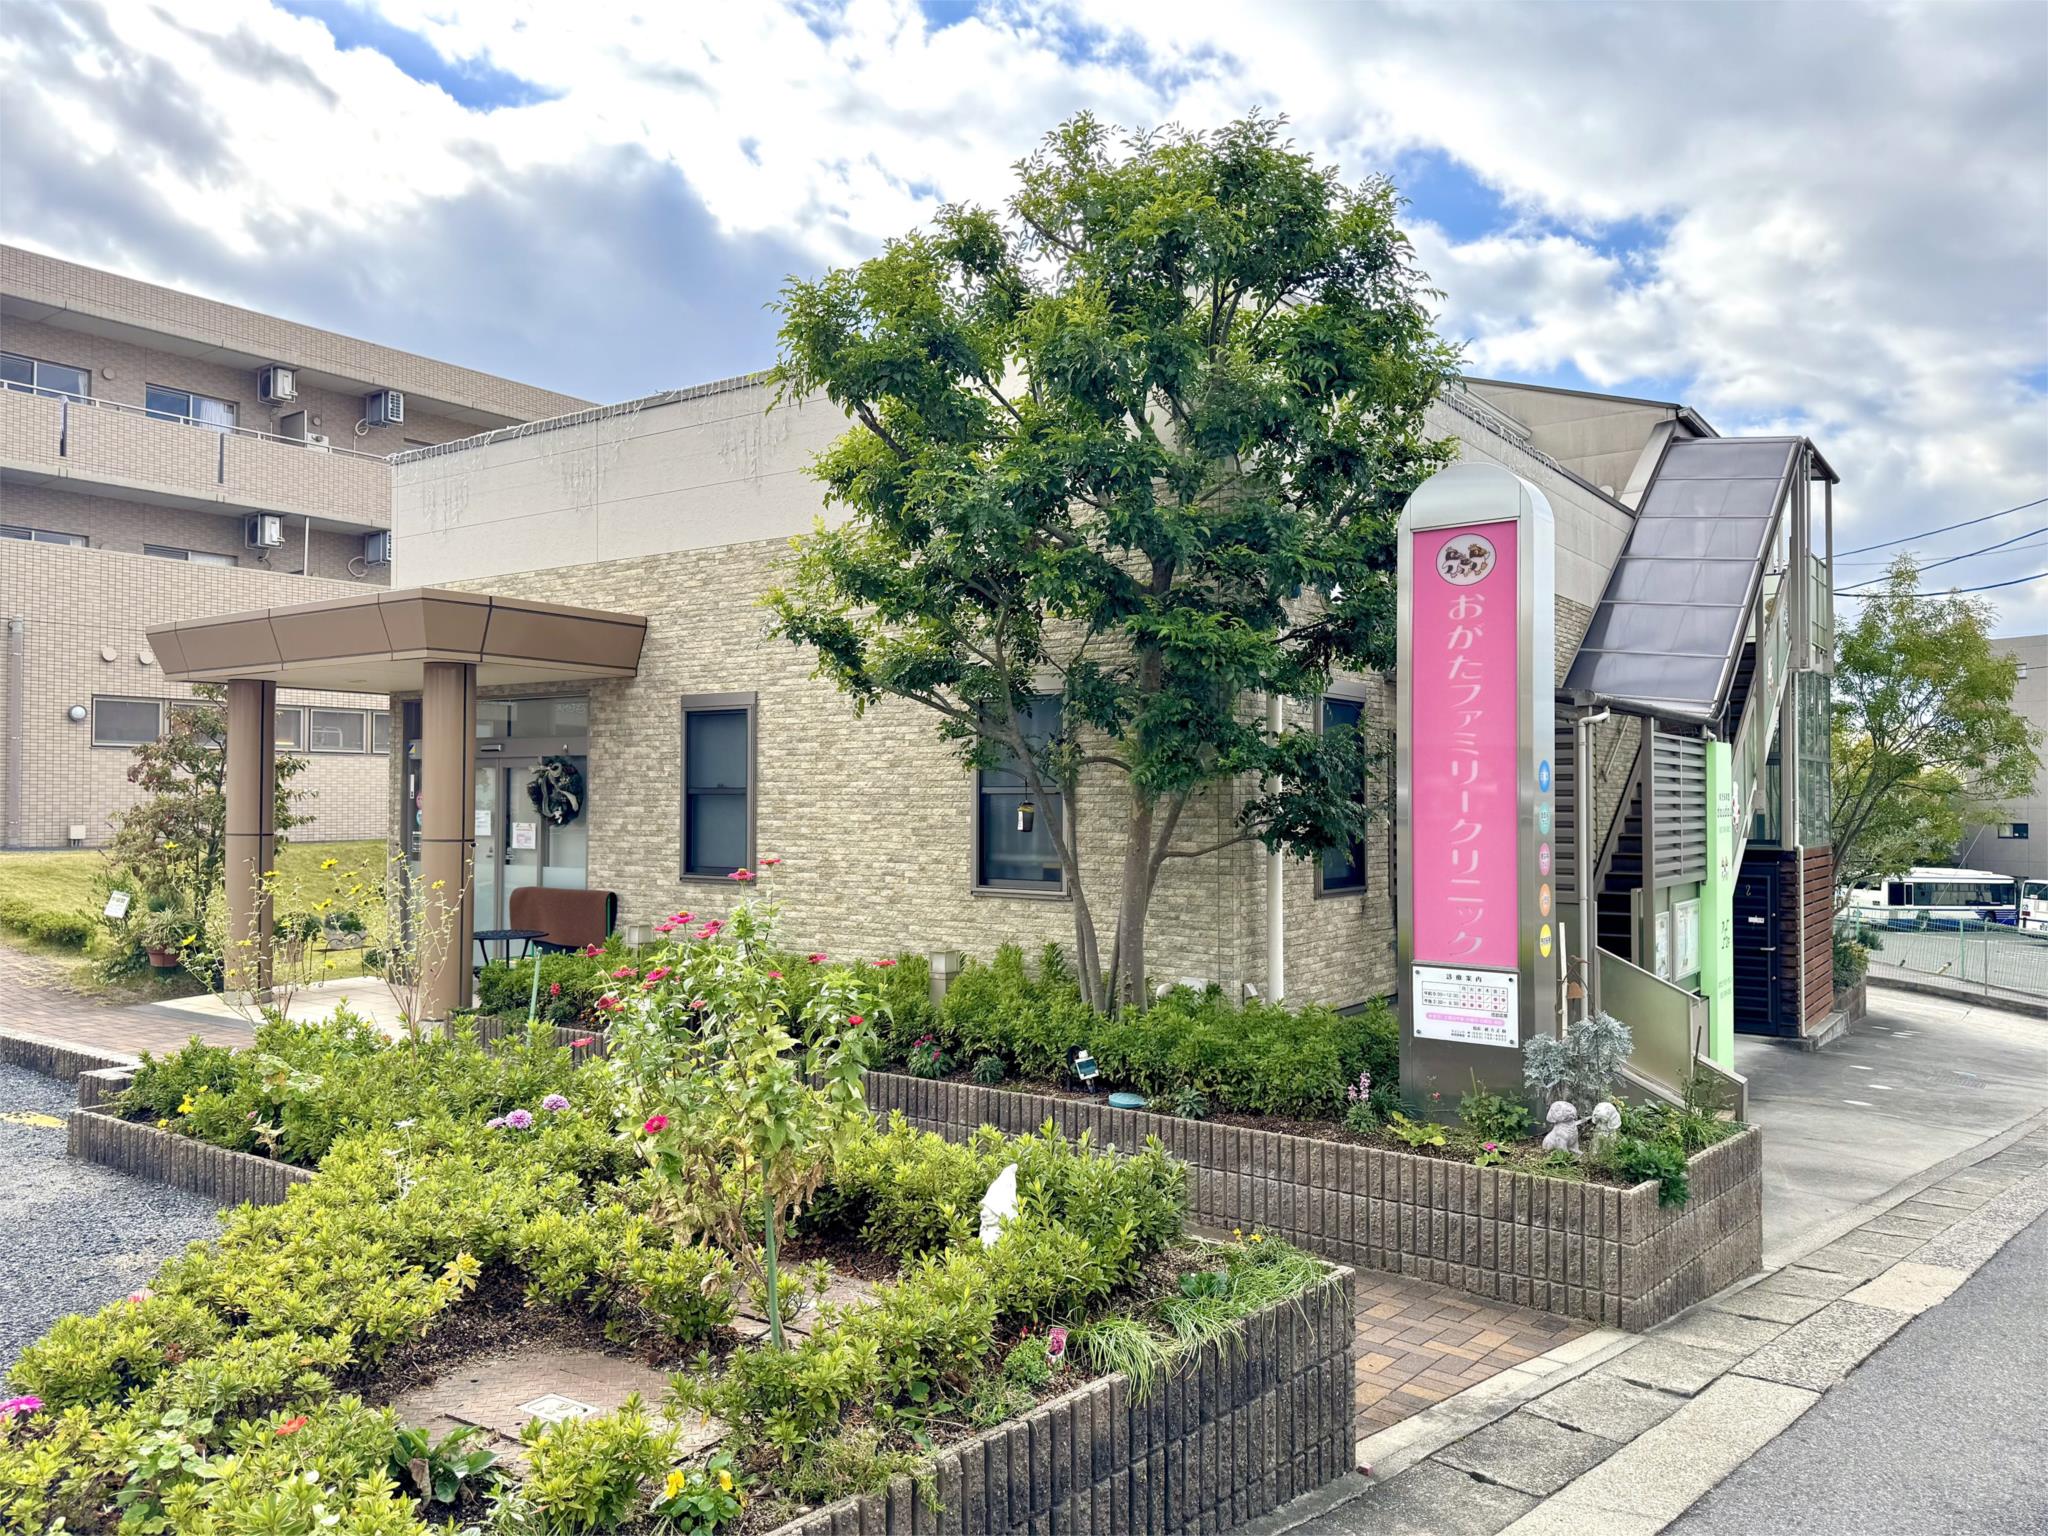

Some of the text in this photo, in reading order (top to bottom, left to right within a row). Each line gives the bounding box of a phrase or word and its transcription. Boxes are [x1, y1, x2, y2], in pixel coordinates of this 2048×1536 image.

[1447, 593, 1487, 956] おがたファミリークリニック
